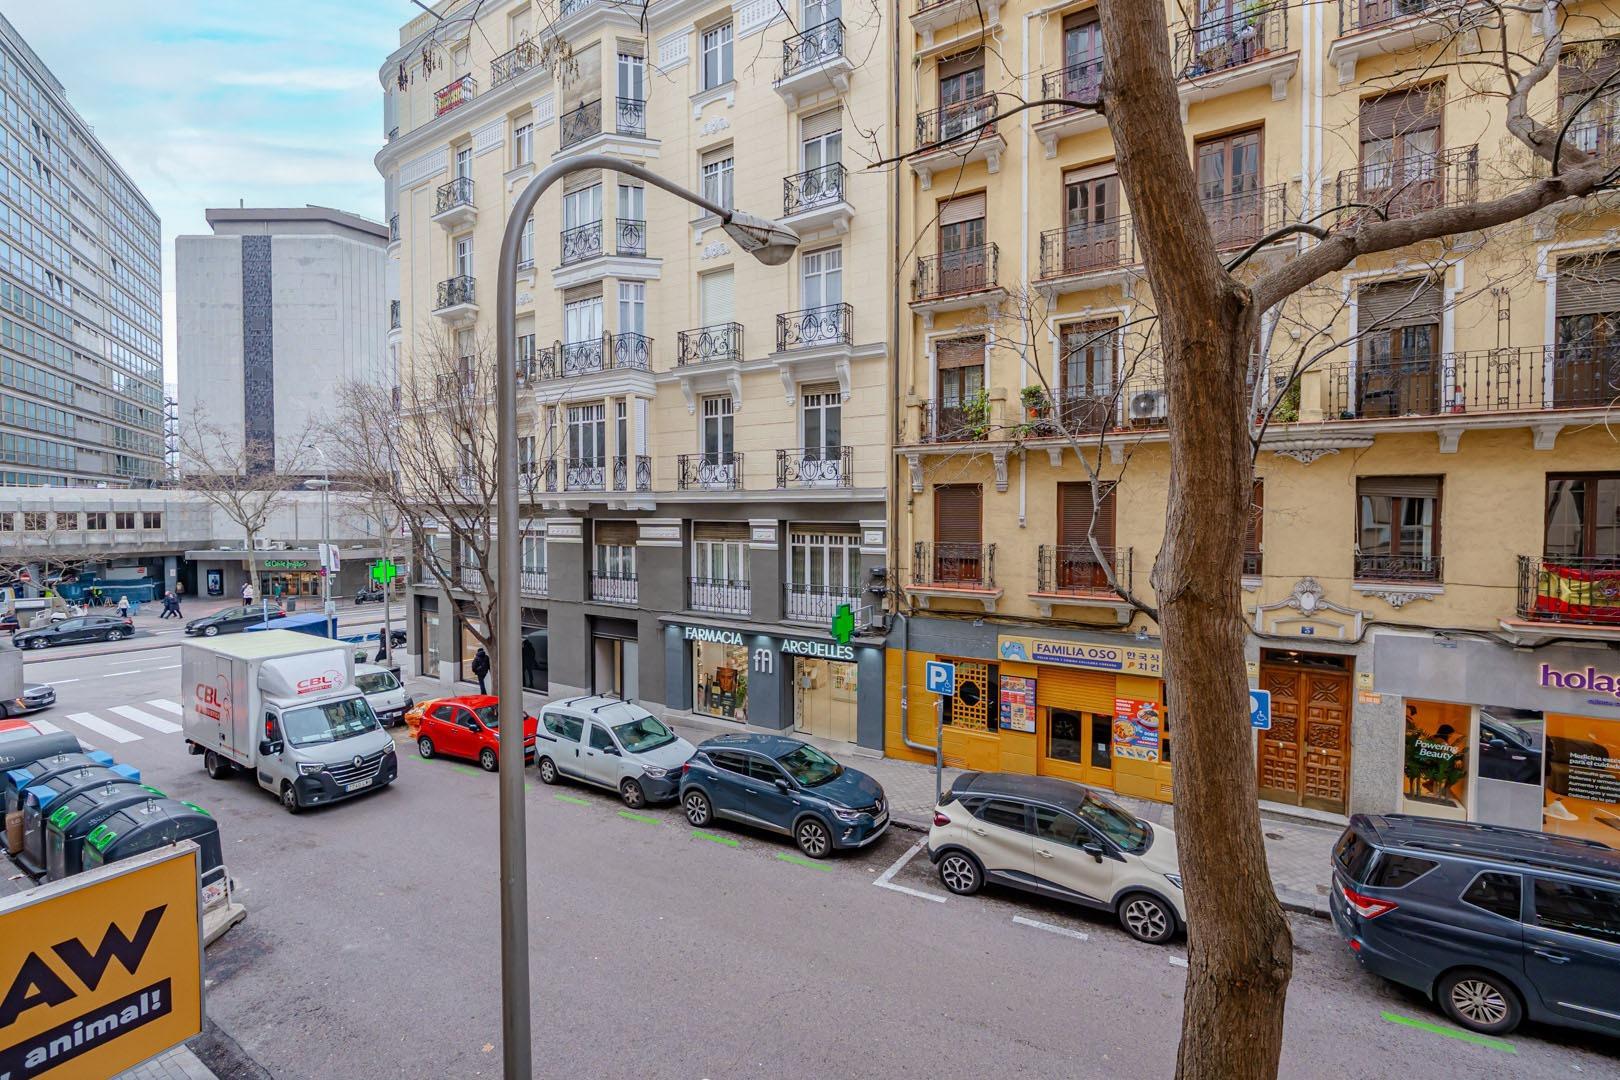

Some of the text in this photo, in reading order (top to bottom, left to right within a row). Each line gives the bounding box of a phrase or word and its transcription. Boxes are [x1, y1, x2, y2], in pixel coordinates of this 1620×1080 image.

[685, 627, 743, 646] FARMACIA
[782, 639, 854, 660] ARGÜELLES
[1037, 643, 1117, 660] FAMILIA OSO
[297, 676, 332, 689] CBL
[930, 665, 947, 689] P
[1542, 664, 1620, 698] hola
[196, 683, 221, 708] CBL
[1415, 739, 1459, 755] Powering
[1420, 748, 1453, 760] Beauty
[25, 989, 161, 1068] animal!
